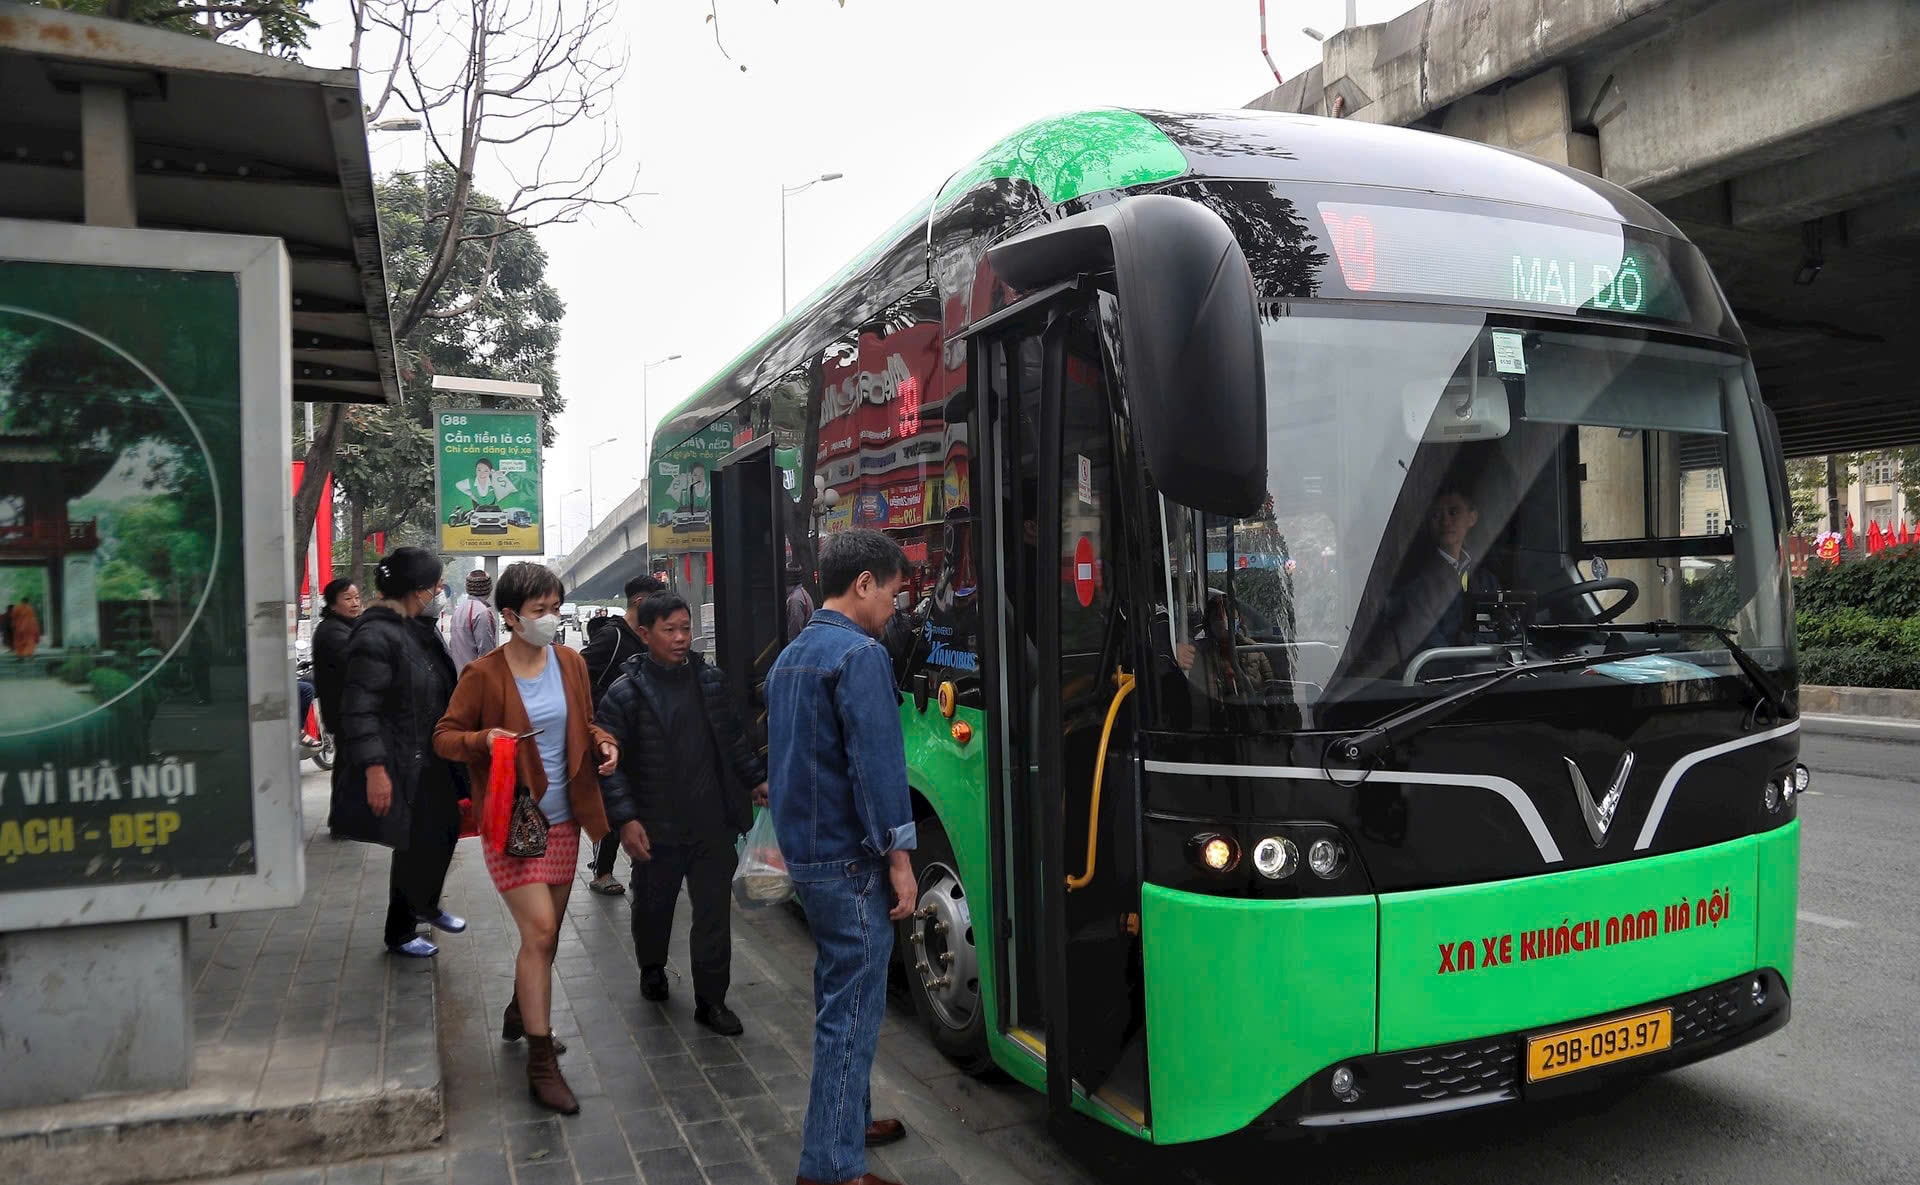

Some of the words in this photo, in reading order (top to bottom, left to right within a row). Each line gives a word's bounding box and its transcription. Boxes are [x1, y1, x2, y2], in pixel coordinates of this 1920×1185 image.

[1511, 254, 1577, 306] MAI
[1590, 256, 1643, 312] ĐÔ
[444, 430, 471, 443] Cần
[474, 431, 498, 444] tiền
[500, 433, 513, 444] là
[516, 433, 532, 444] có
[18, 762, 57, 805] VÌ
[67, 758, 122, 803] HÀ
[130, 755, 197, 805] NỘI
[109, 811, 182, 854] ĐẸP
[1481, 934, 1512, 968] XE
[1520, 918, 1600, 962] KHÁCH
[1605, 909, 1658, 947] NAM
[1664, 897, 1690, 934] HÀ
[1541, 1019, 1660, 1071] 29B-093.97
